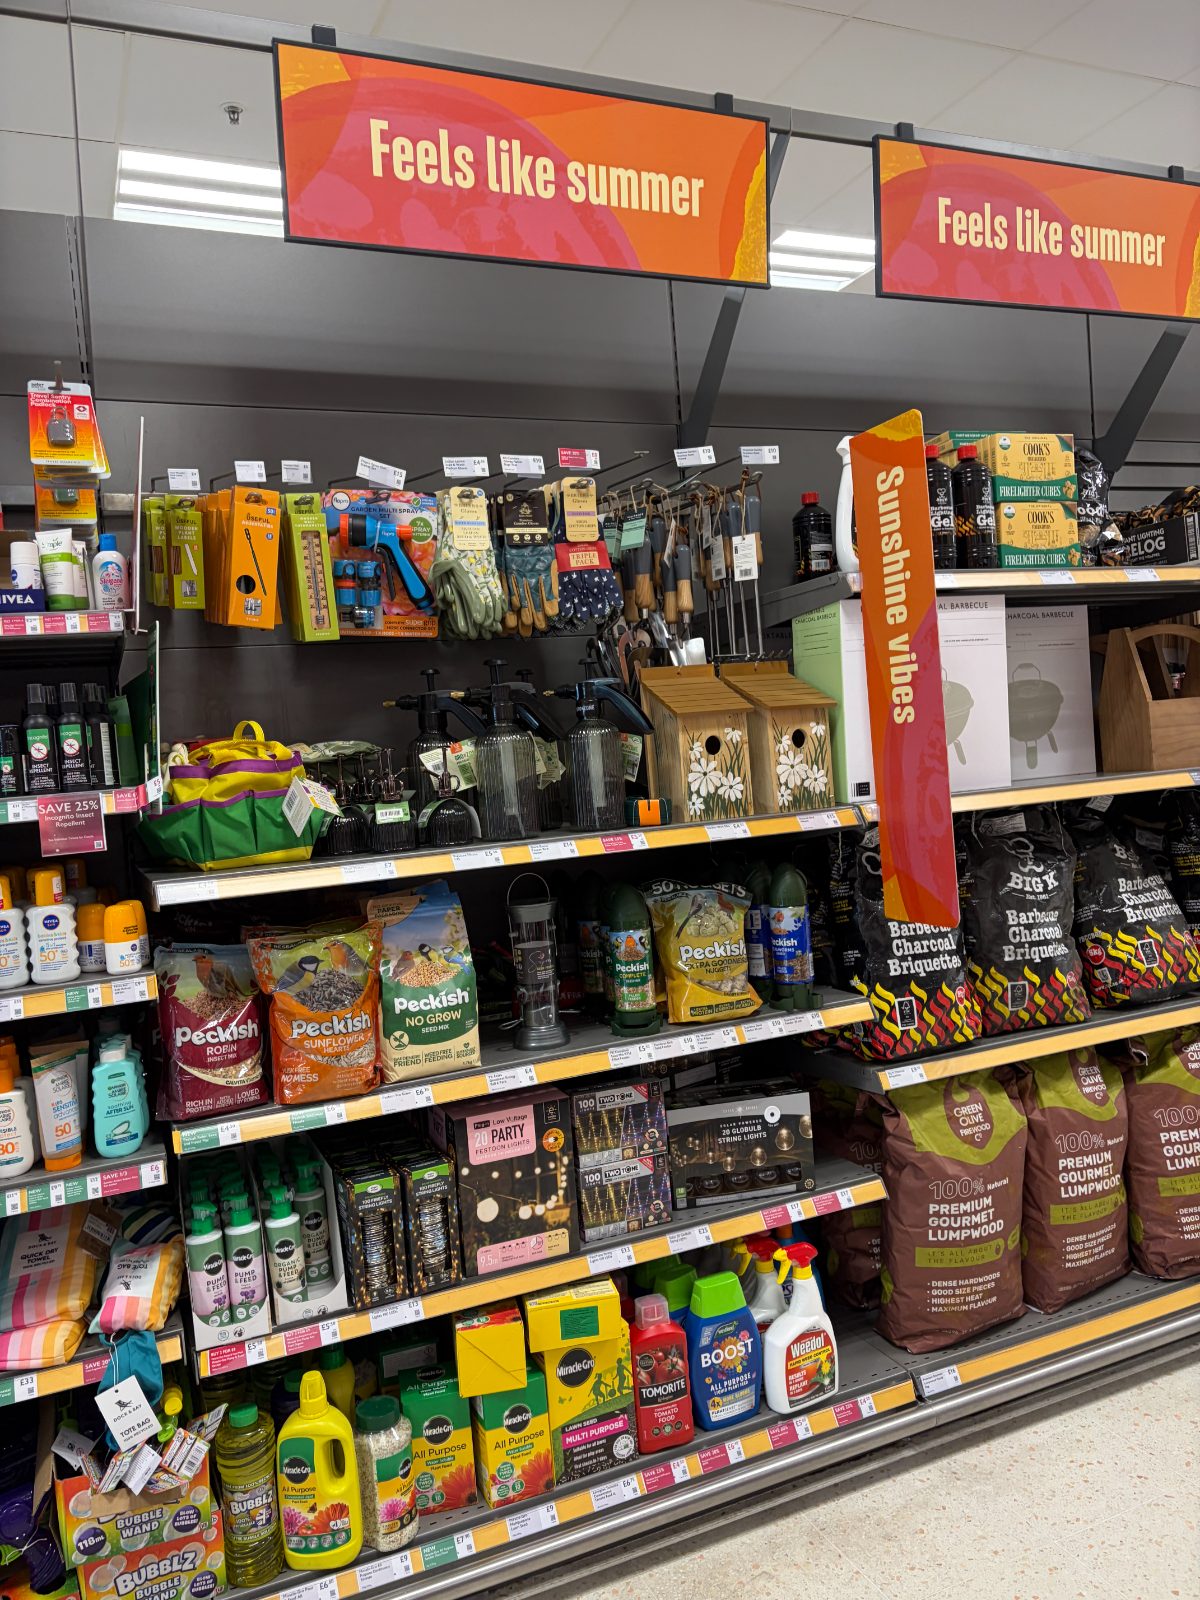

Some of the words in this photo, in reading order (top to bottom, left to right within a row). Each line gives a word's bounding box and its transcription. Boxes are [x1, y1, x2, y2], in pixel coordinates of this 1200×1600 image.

[370, 118, 474, 188] Feels
[486, 135, 555, 198] like
[567, 160, 704, 216] summer
[938, 197, 1007, 250] Feels
[1016, 206, 1062, 255] like
[1070, 224, 1166, 266] summer
[1023, 443, 1050, 456] COOK'S
[999, 486, 1040, 497] FIRELIGHTER
[1041, 485, 1061, 497] CUBES
[1028, 511, 1054, 523] COOK'S
[876, 466, 911, 625] Sunshine
[1005, 554, 1045, 566] FIRELIGHTER
[1046, 553, 1066, 564] CUBES
[950, 602, 989, 610] BARBECUE
[888, 633, 918, 724] vibes
[39, 802, 71, 814] SAVE
[75, 800, 98, 811] 25%
[44, 814, 75, 822] Incognito
[1007, 871, 1043, 892] BIG
[1006, 908, 1058, 924] Barbecue
[1008, 923, 1063, 943] Charcoal
[892, 933, 957, 957] Charcoal
[1003, 942, 1068, 964] Briquettes
[615, 961, 649, 972] Peckish
[888, 954, 962, 977] Briquettes
[394, 988, 469, 1014] Peckish
[291, 1011, 370, 1038] Peckish
[406, 1016, 424, 1028] NO
[426, 1009, 462, 1025] GROW
[176, 1019, 258, 1047] Peckish
[206, 1043, 237, 1055] ROBIN
[304, 1034, 365, 1049] SUNFLOWER
[393, 1059, 422, 1067] FRIEND
[424, 1054, 453, 1063] FEEDING
[294, 1073, 319, 1082] MESS
[1080, 1075, 1103, 1085] OLIVE
[237, 1088, 259, 1100] LOVED
[579, 1099, 594, 1108] 100
[600, 1095, 614, 1103] TWO
[106, 1107, 122, 1116] AFTER
[186, 1100, 204, 1108] RICH
[186, 1105, 213, 1114] PROTEIN
[953, 1103, 984, 1117] GREEN
[959, 1112, 984, 1127] OLIVE
[55, 1122, 71, 1137] 50
[475, 1131, 488, 1148] 20
[491, 1123, 525, 1143] PARTY
[731, 1125, 762, 1135] GLOBULB
[960, 1122, 991, 1137] FIREWOOD
[718, 1135, 742, 1144] STRING
[744, 1132, 767, 1141] LIGHTS
[1055, 1130, 1105, 1154] 100%
[1107, 1135, 1124, 1146] Natural
[475, 1145, 506, 1155] FESTOON
[508, 1139, 530, 1148] LIGHTS
[1059, 1150, 1112, 1170] PREMIUM
[584, 1172, 600, 1183] 100
[1059, 1163, 1113, 1184] GOURMET
[929, 1176, 984, 1199] 100%
[987, 1177, 1009, 1191] Natural
[1061, 1175, 1121, 1198] LUMPWOOD
[928, 1195, 992, 1215] PREMIUM
[928, 1209, 995, 1227] GOURMET
[928, 1220, 1004, 1241] LUMPWOOD
[20, 1251, 43, 1260] QUICK
[27, 1256, 51, 1264] TOWEL
[959, 1272, 1001, 1286] HARDWOODS
[955, 1286, 971, 1294] SIZE
[972, 1281, 995, 1292] PIECES
[931, 1297, 964, 1305] HIGHEST
[966, 1293, 983, 1302] HEAT
[931, 1305, 968, 1313] MAXIMUM
[969, 1296, 997, 1310] FLAVOUR
[700, 1338, 754, 1368] BOOST
[790, 1332, 825, 1359] Weedol
[556, 1359, 595, 1377] Miracle-Gro
[20, 1377, 34, 1386] £33
[641, 1379, 686, 1398] TOMORITE
[710, 1383, 722, 1392] ALL
[723, 1372, 751, 1388] PURPOSE
[710, 1399, 721, 1408] 4x
[654, 1408, 679, 1418] TOMATO
[658, 1415, 675, 1423] FOOD
[120, 1425, 138, 1438] TOTE
[137, 1417, 151, 1429] BAG
[565, 1423, 582, 1432] LAWN
[566, 1434, 588, 1445] MULTI
[589, 1420, 624, 1435] PURPOSE
[494, 1440, 506, 1450] All
[508, 1429, 544, 1445] Purpose
[413, 1451, 426, 1460] All
[428, 1443, 466, 1457] Purpose
[230, 1490, 273, 1514] BUBBLZ
[116, 1507, 164, 1529] BUBBLE
[120, 1520, 160, 1539] WAND
[114, 1551, 197, 1596] BUBBLZ
[135, 1575, 181, 1600] BUBBLE
